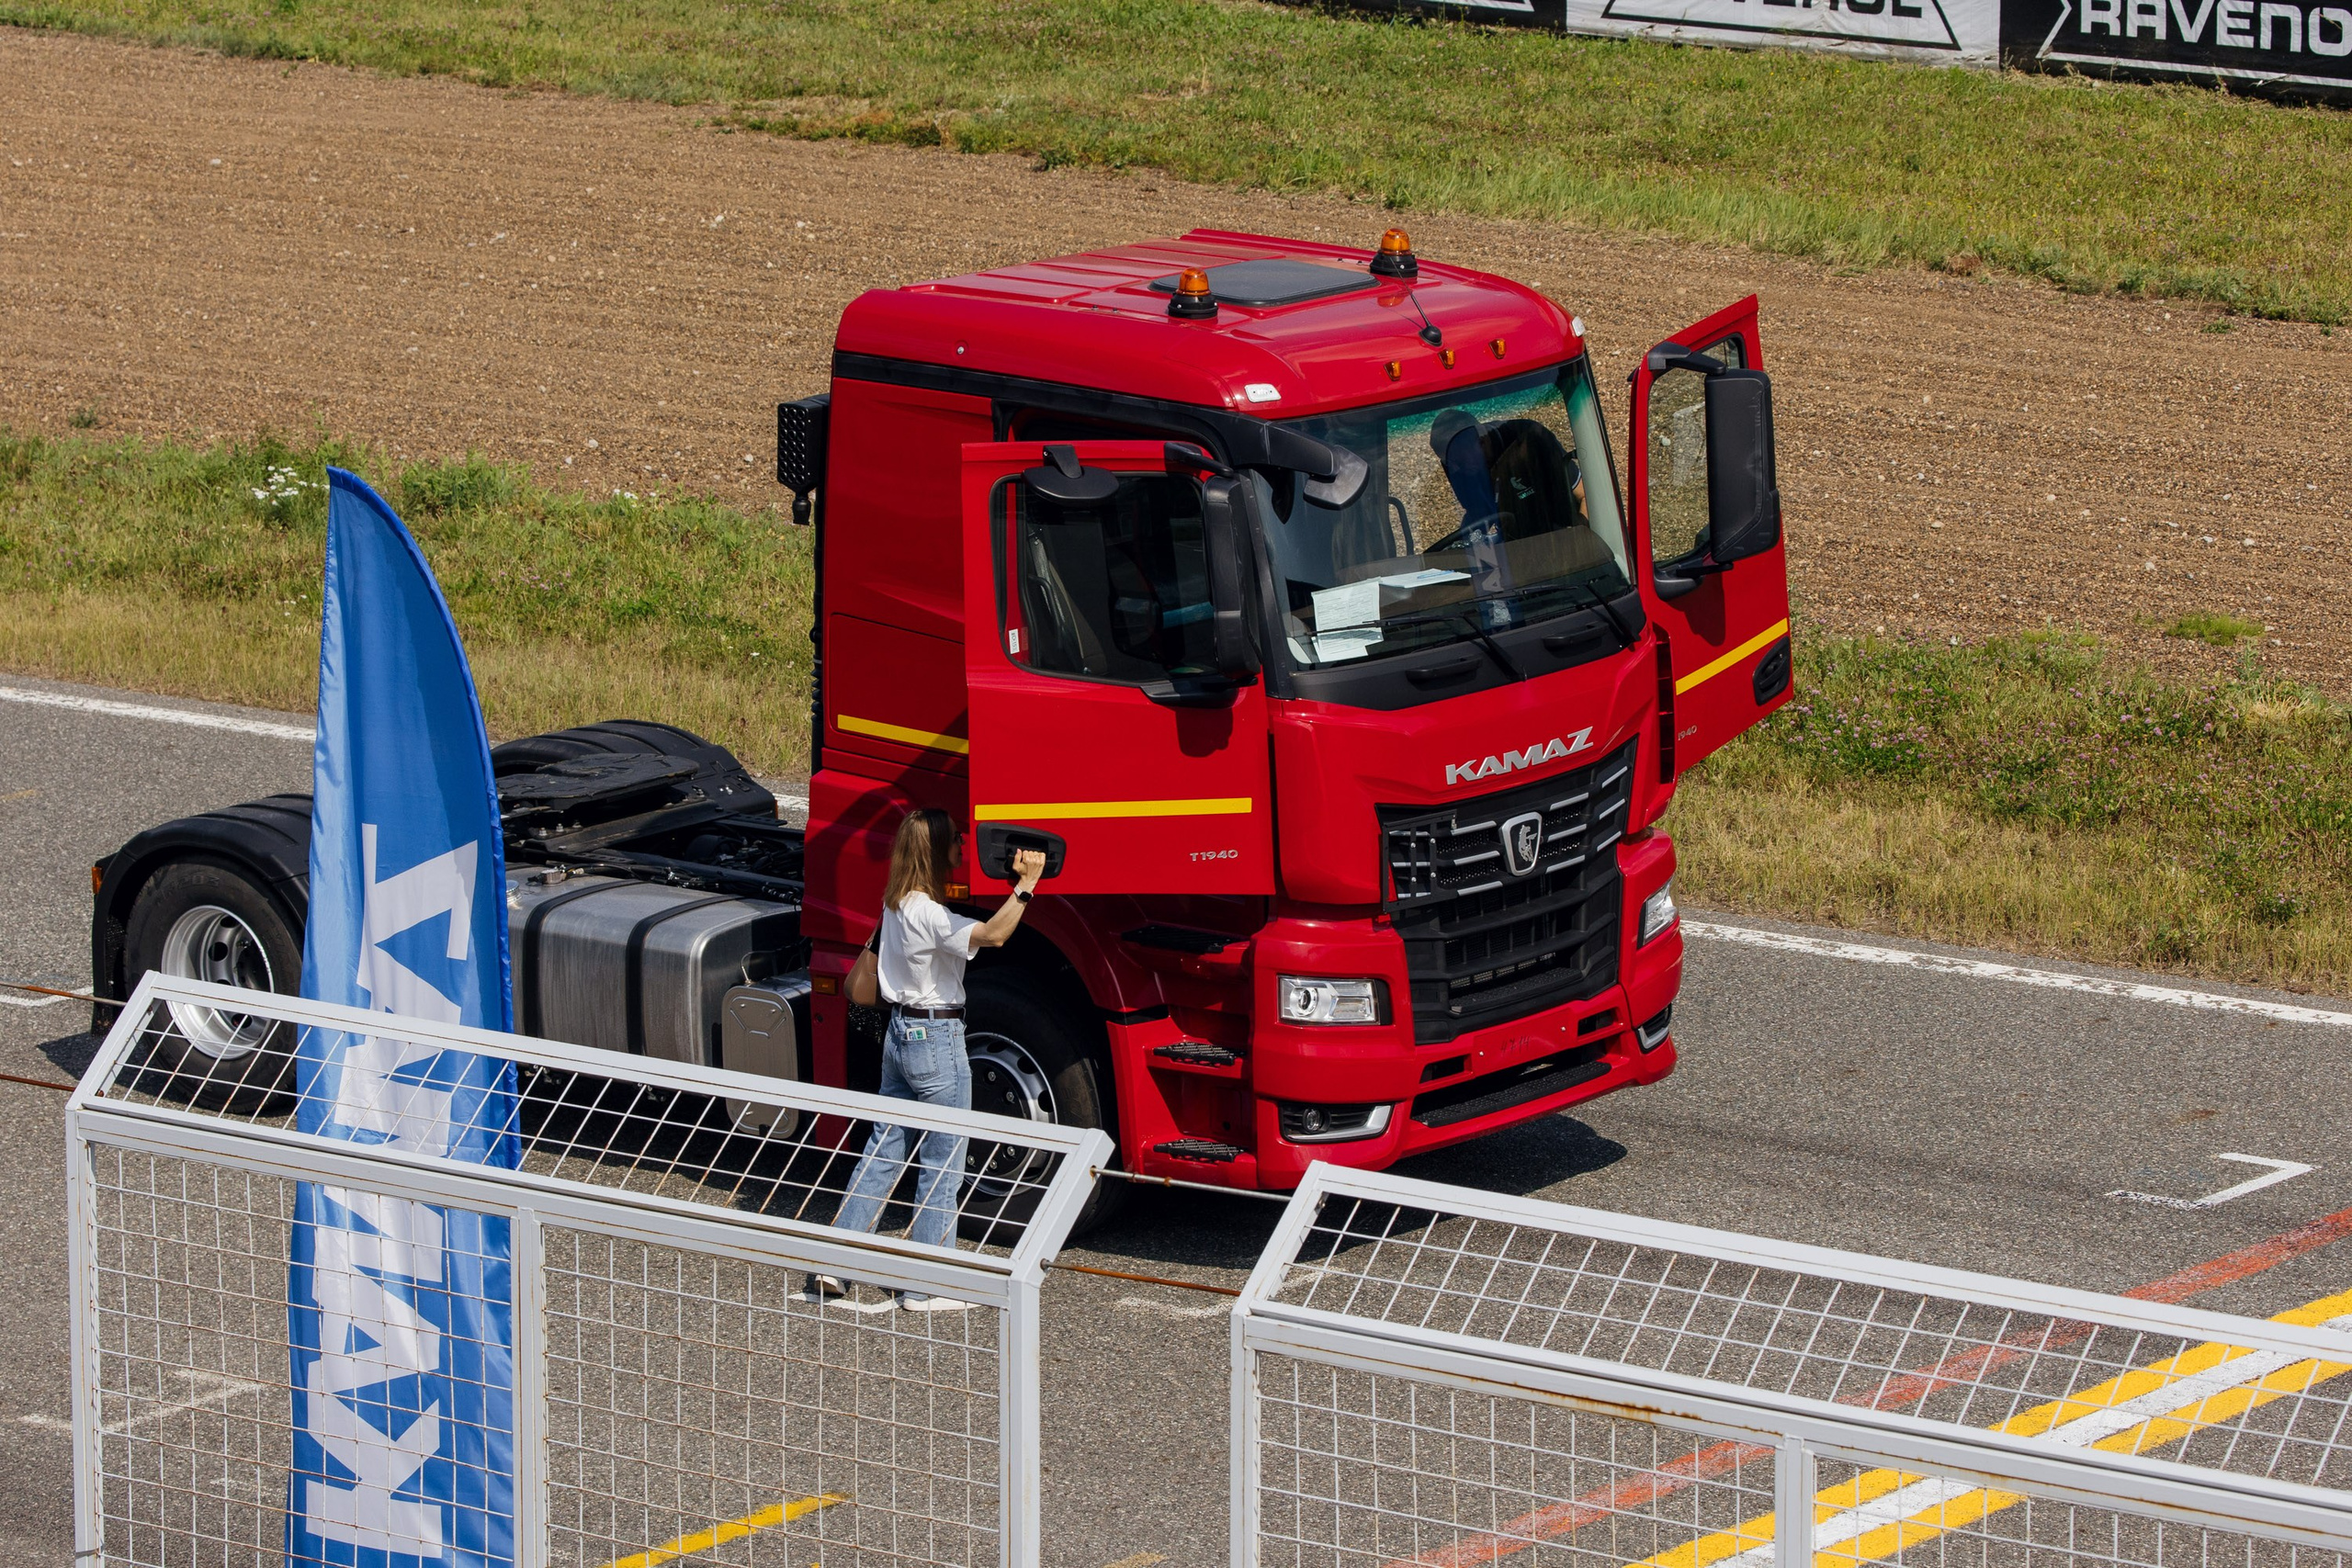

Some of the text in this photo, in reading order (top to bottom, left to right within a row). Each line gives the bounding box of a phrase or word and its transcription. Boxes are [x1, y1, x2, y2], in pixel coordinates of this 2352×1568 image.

[1445, 726, 1594, 785] KAMAZ
[1189, 849, 1239, 862] T1940
[306, 823, 478, 1559] KAMAZ
